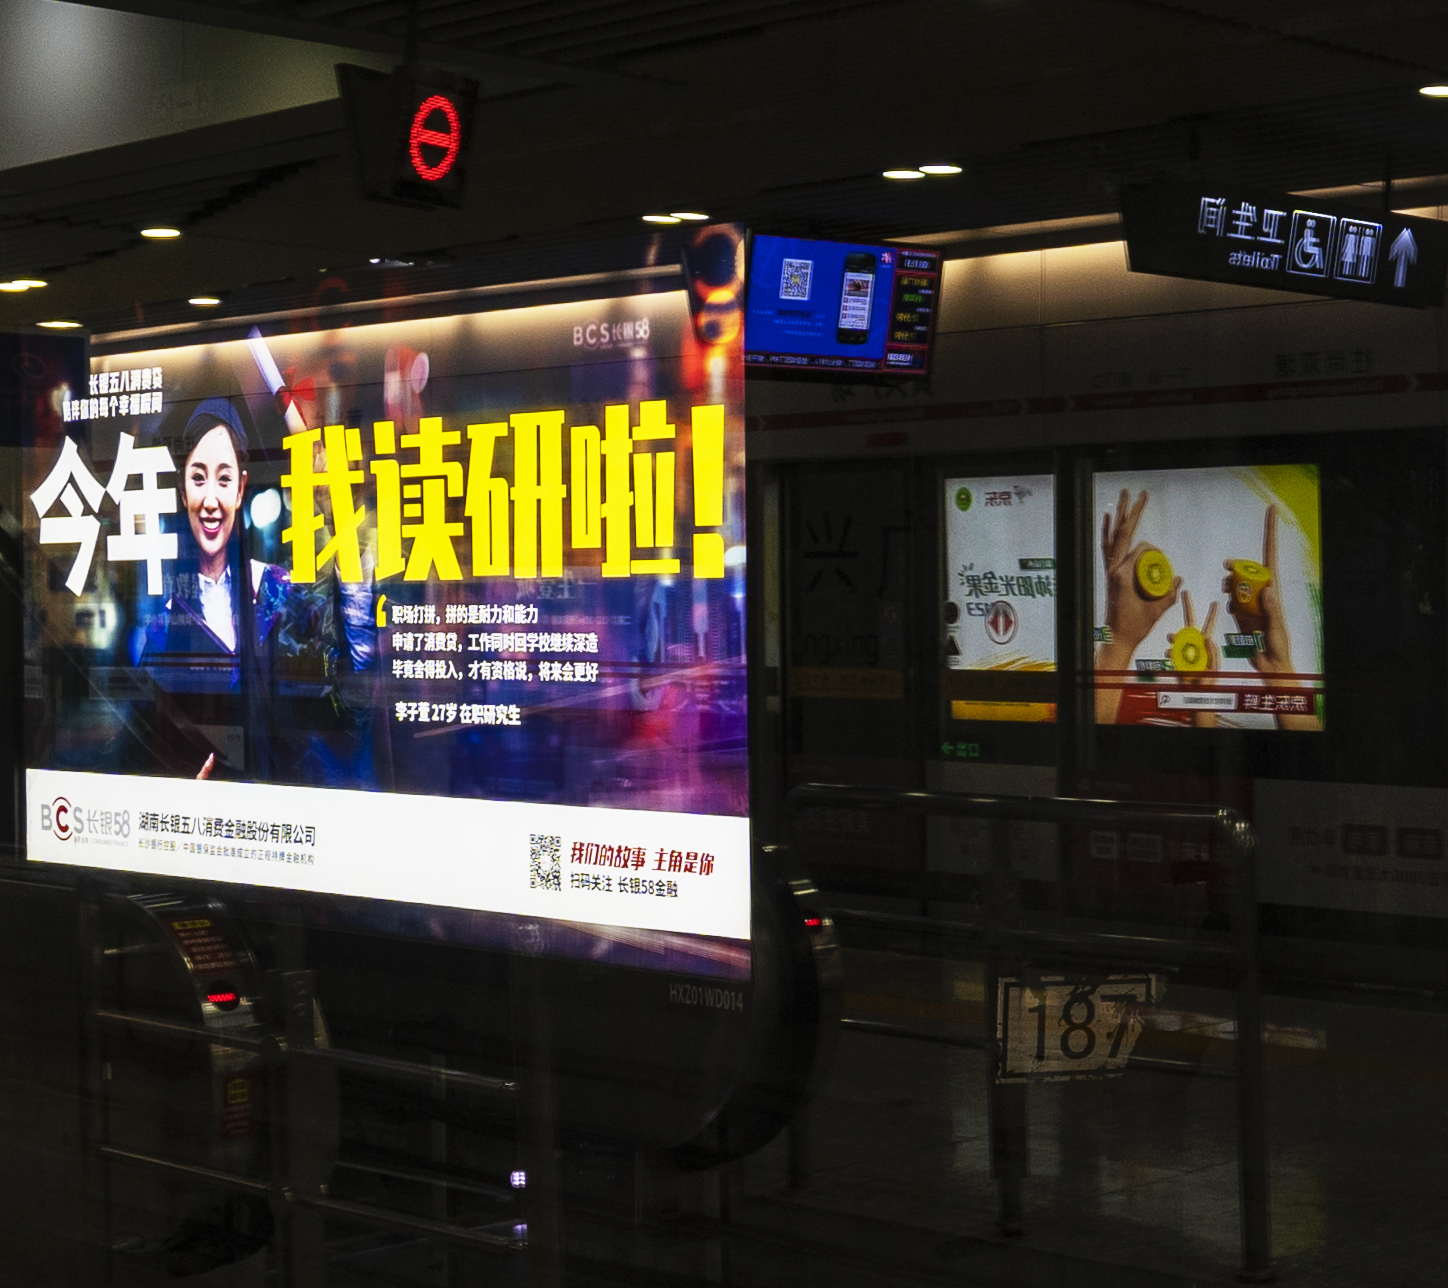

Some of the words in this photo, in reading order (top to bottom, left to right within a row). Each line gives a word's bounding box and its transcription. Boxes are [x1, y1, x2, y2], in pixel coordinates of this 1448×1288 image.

[29, 431, 179, 597] 今年
[431, 702, 458, 724] 27岁
[458, 703, 522, 726] 在职研究生
[40, 796, 85, 842] BCS
[138, 811, 317, 847] 湖南长银五八消费金融股份有限公司
[569, 841, 648, 872] 我们的故事
[651, 847, 716, 876] 主角是你
[570, 871, 614, 893] 扫码关注
[617, 875, 679, 899] 长银58金融
[1027, 990, 1139, 1063] 187
